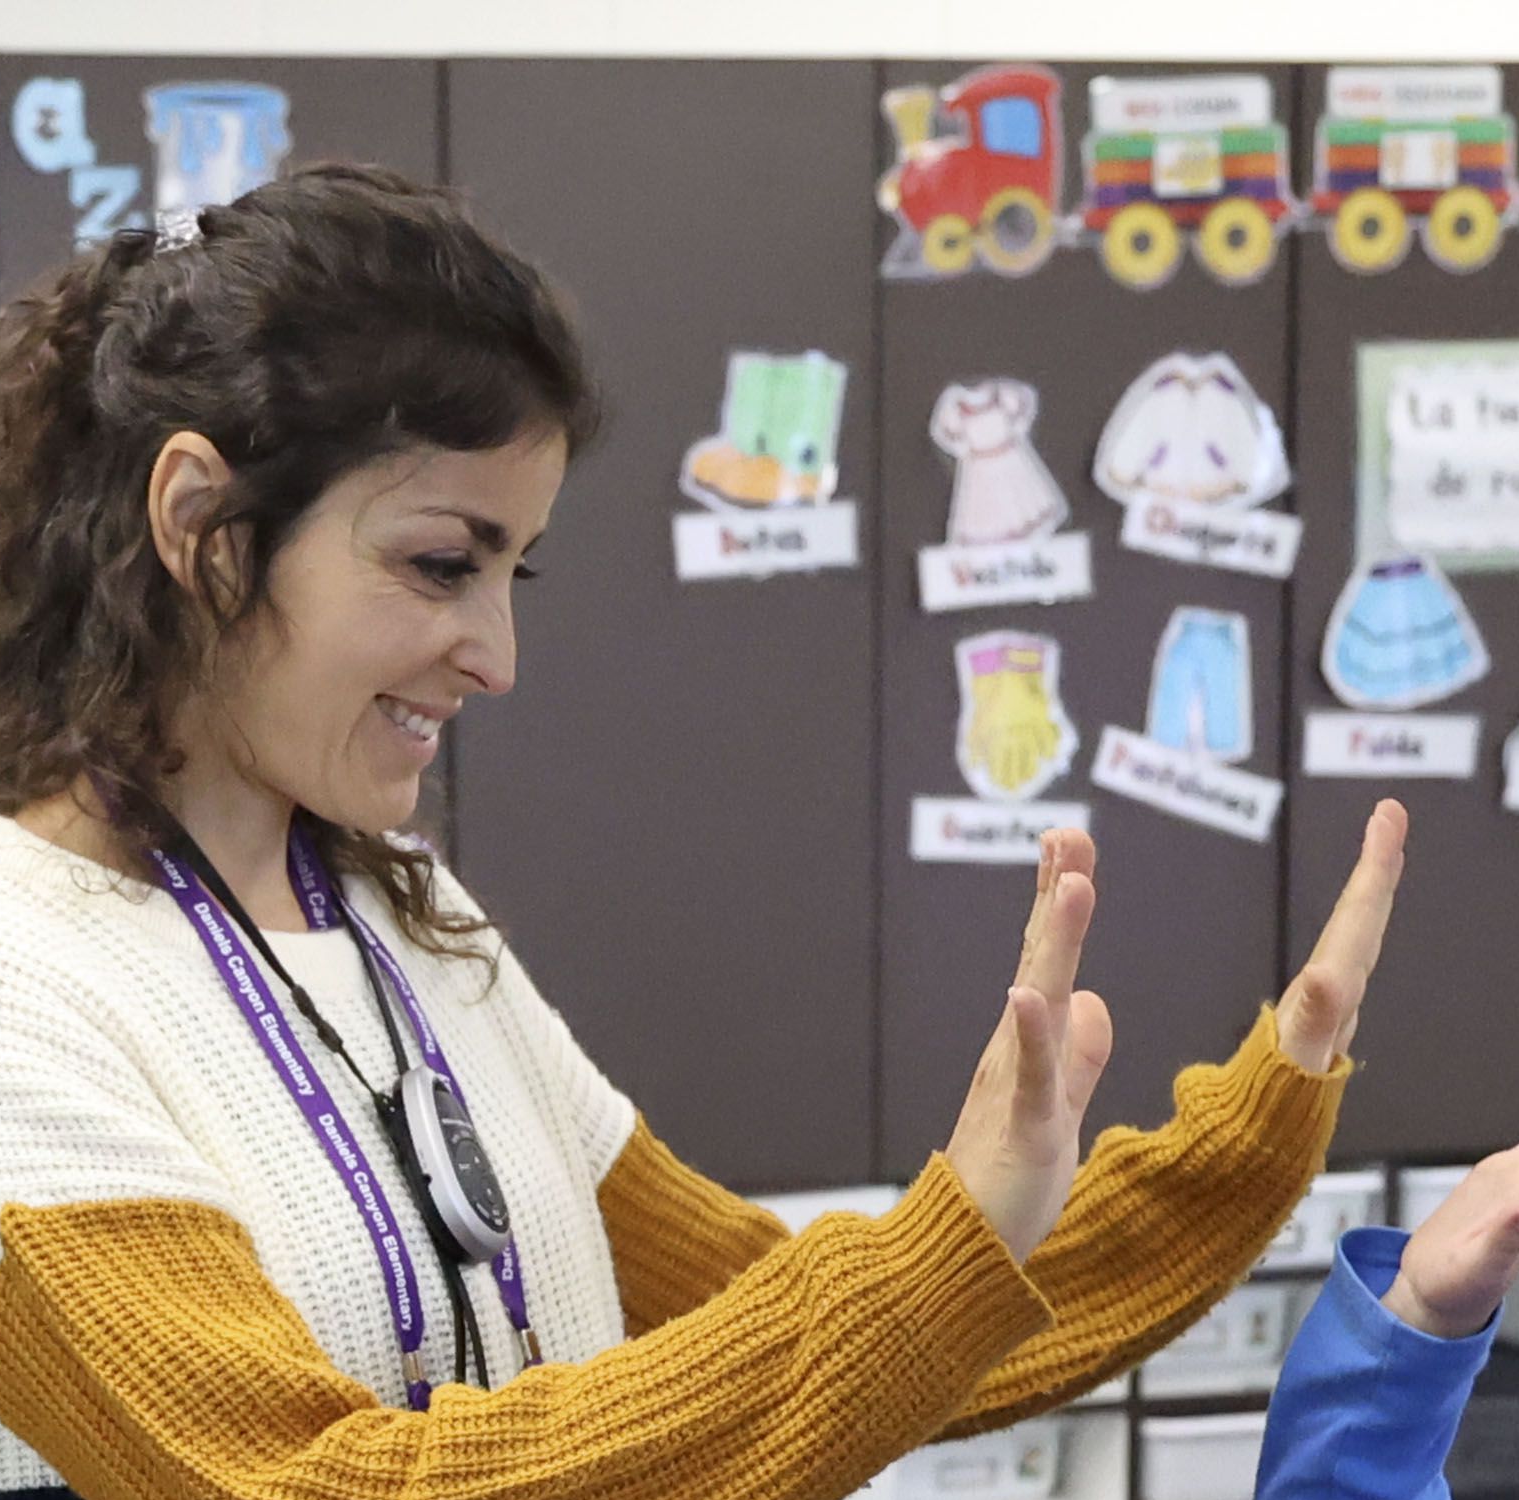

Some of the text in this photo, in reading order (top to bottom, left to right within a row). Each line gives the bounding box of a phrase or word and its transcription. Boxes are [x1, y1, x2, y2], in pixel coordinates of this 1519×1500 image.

[12, 77, 149, 252] az
[193, 902, 317, 1097] Daniels Canyon Elementary
[318, 1112, 413, 1332] Daniels Canyon Elementary
